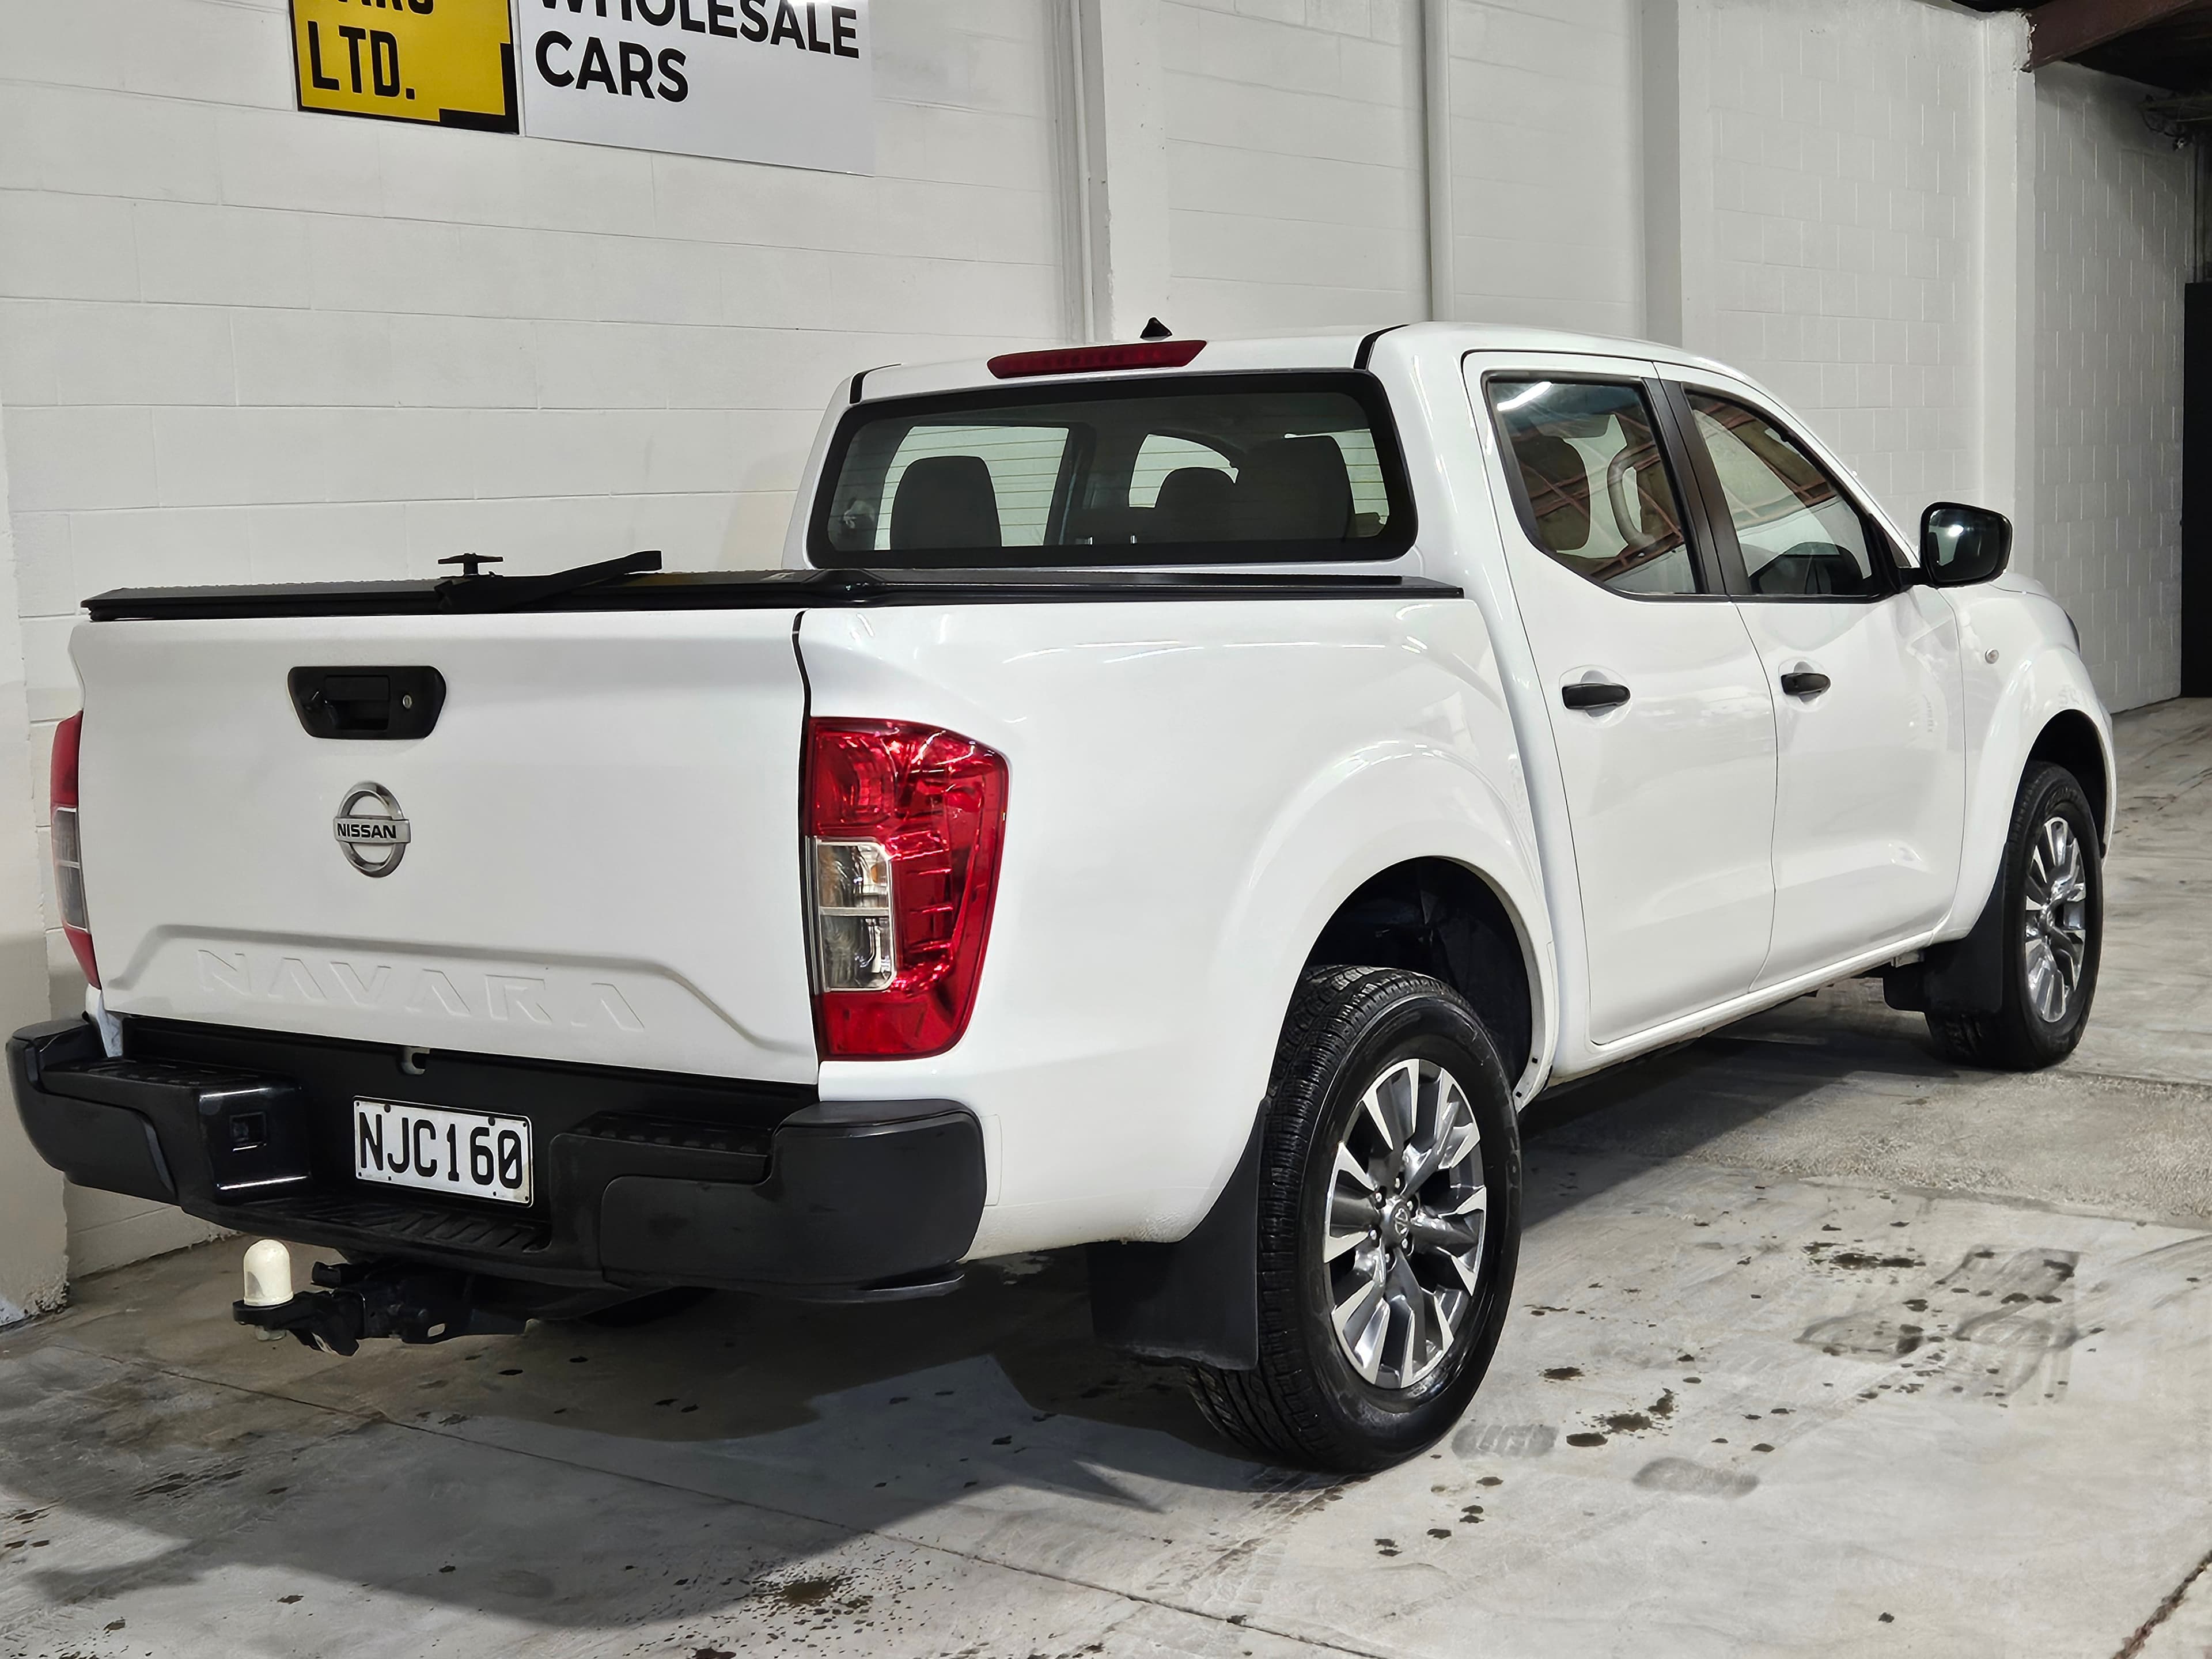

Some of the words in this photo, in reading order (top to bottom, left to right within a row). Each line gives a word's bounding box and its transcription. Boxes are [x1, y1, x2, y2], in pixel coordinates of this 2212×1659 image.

[308, 20, 415, 100] LTD.
[541, 0, 859, 58] LESALE
[536, 31, 688, 103] CARS
[337, 823, 397, 839] NISSAN
[196, 949, 646, 1031] NAVARA
[359, 1112, 523, 1190] NJC160
